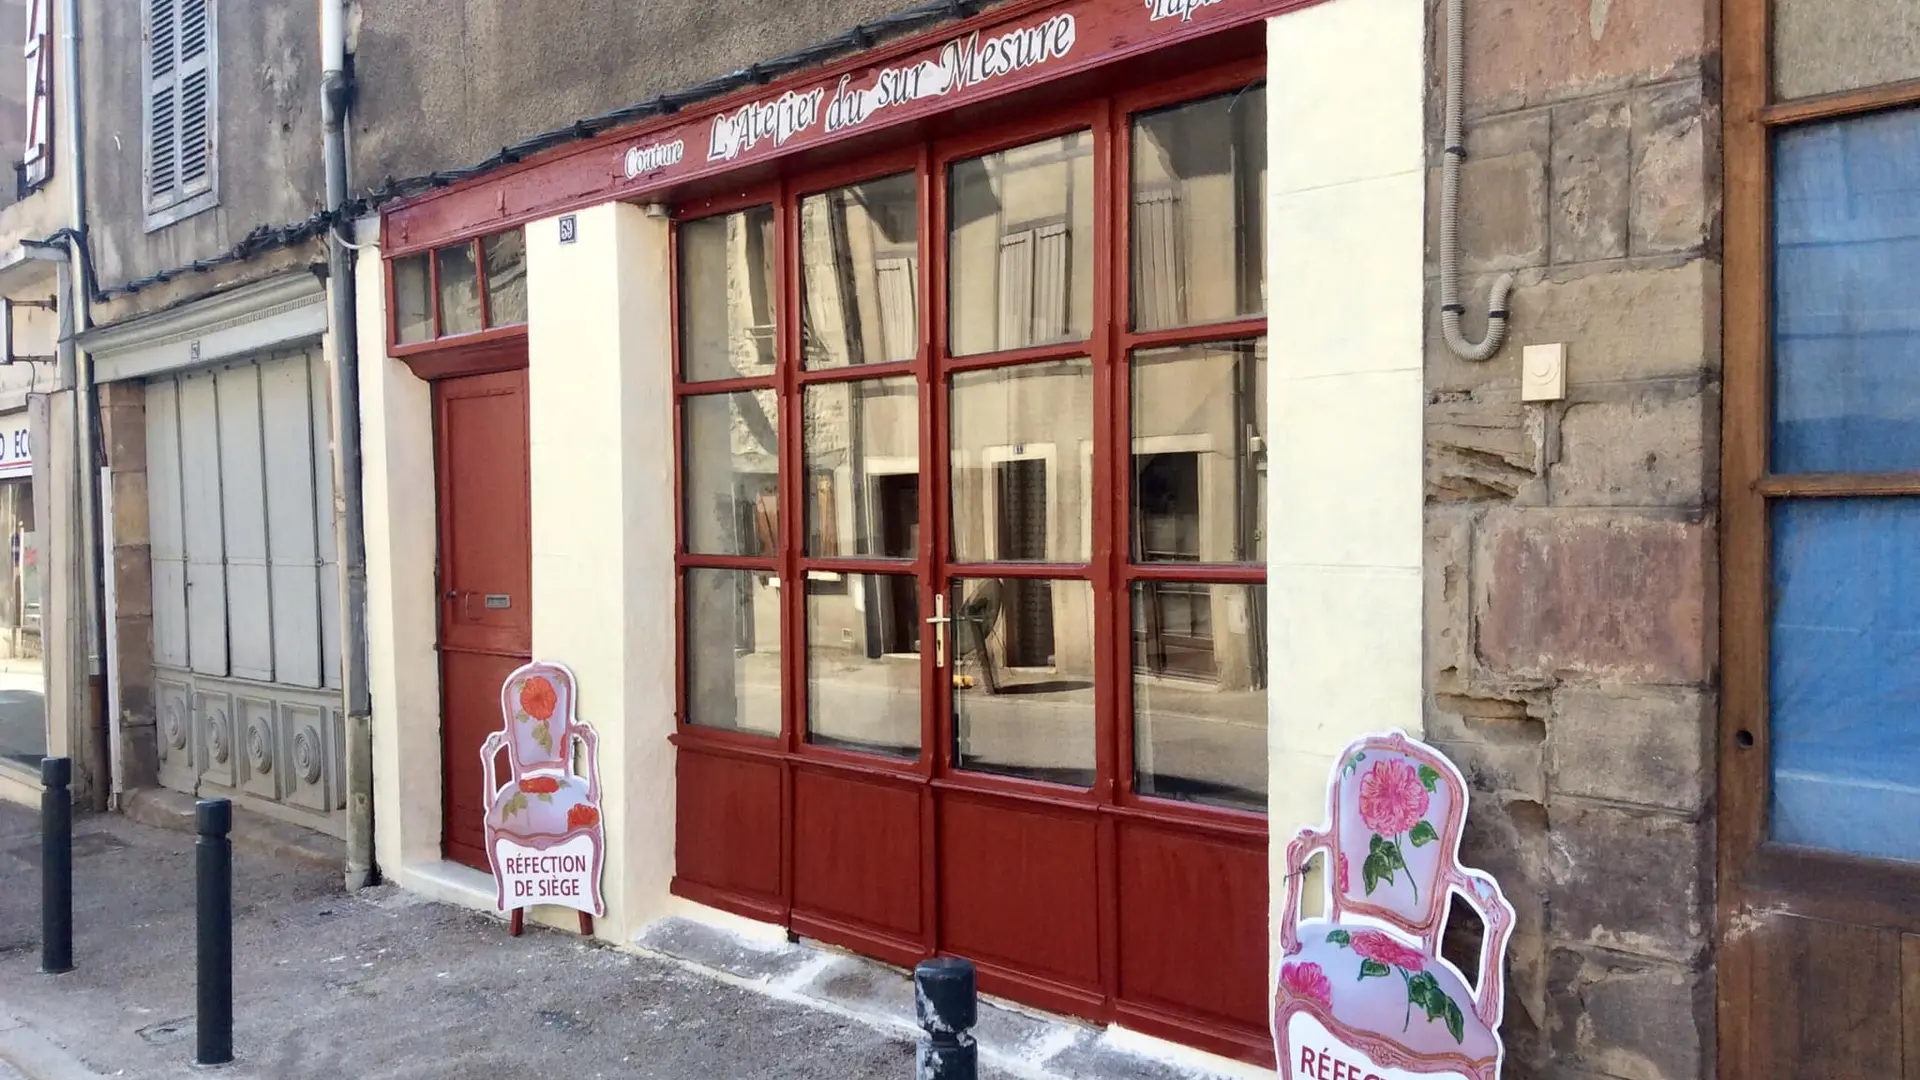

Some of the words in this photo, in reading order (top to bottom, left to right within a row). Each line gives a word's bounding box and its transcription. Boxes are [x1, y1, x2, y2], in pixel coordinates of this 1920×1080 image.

[709, 88, 822, 158] L'Atelier
[828, 75, 863, 130] du
[878, 63, 926, 105] sur
[941, 15, 1070, 91] Mesure
[626, 141, 682, 177] Couture
[561, 219, 573, 240] 59
[506, 852, 587, 875] RÉFECTION
[515, 880, 534, 897] DE
[538, 875, 581, 897] SIÈGE
